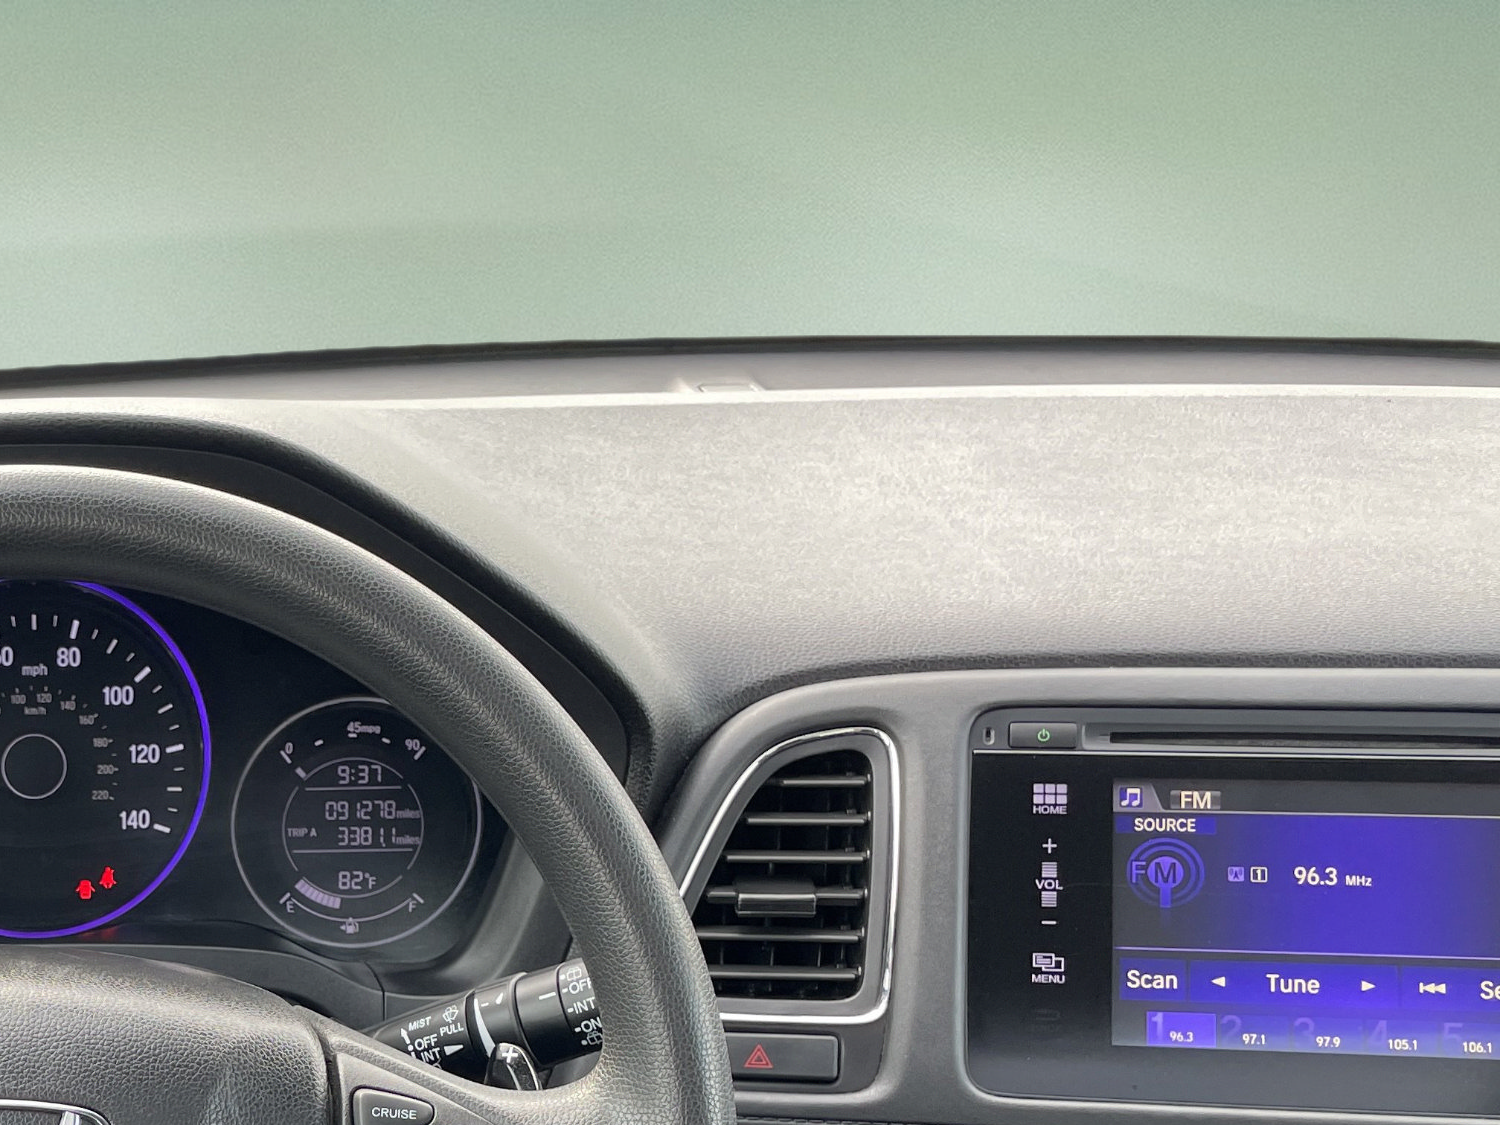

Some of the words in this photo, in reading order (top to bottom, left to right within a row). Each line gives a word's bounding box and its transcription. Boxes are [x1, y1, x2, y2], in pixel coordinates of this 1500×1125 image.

[56, 646, 81, 668] 80
[21, 663, 48, 677] mph
[102, 685, 134, 706] 100
[285, 742, 294, 755] 0
[405, 738, 421, 751] 90
[129, 743, 160, 764] 120
[337, 764, 382, 785] 9:37
[1179, 791, 1212, 810] FM
[324, 800, 396, 821] 091278
[1032, 804, 1068, 815] HOME
[119, 809, 151, 830] 140
[1133, 818, 1197, 833] SOURCE
[287, 827, 309, 838] TRIP
[310, 829, 317, 838] A
[1293, 866, 1339, 886] 96.3
[1345, 876, 1373, 887] MHz
[1035, 879, 1063, 891] VOL
[286, 900, 295, 914] E
[408, 900, 417, 913] F
[1031, 973, 1066, 985] MENU
[1126, 969, 1179, 990] Scan
[1265, 973, 1321, 995] Tune
[573, 996, 595, 1014] INT
[408, 1016, 432, 1032] MIST
[440, 1022, 465, 1037] PULL
[414, 1033, 438, 1051] OFF
[1169, 1031, 1194, 1043] 96.3
[1242, 1034, 1267, 1046] 97.1
[1315, 1036, 1341, 1048] 97.9
[1388, 1039, 1418, 1051] 105.1
[1462, 1041, 1493, 1054] 106.1
[420, 1047, 441, 1064] INT
[371, 1107, 417, 1120] CRUISE
